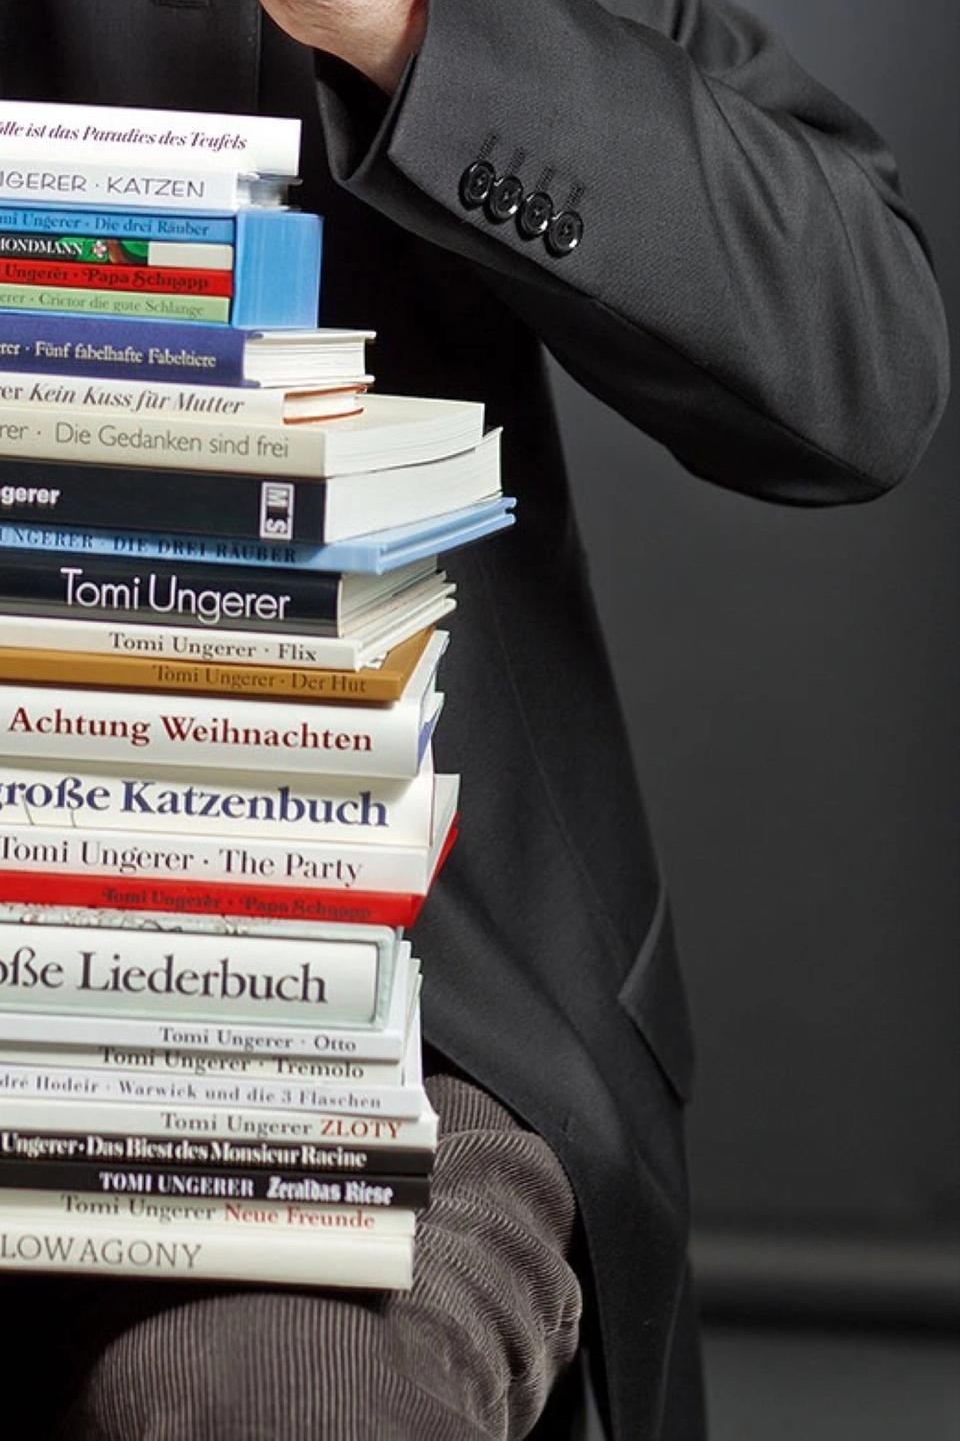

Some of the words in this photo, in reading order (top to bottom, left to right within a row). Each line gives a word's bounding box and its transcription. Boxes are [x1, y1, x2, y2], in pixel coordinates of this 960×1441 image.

[26, 123, 47, 137] ist
[49, 124, 80, 140] das
[83, 125, 157, 145] Paradies
[159, 130, 188, 147] des
[190, 131, 248, 151] Teufels
[107, 176, 206, 198] KATZEN
[22, 213, 83, 230] Ungerer
[95, 219, 121, 233] Die
[122, 219, 152, 233] drei
[82, 268, 129, 285] Papa
[132, 270, 209, 291] Schnapp
[88, 295, 110, 310] die
[113, 299, 141, 314] gute
[145, 299, 204, 318] Schlange
[75, 343, 142, 364] fabelhafte
[148, 348, 217, 368] Fabeltiere
[29, 382, 77, 405] Kein
[82, 385, 131, 406] Kuss
[131, 390, 170, 413] für
[172, 391, 246, 415] Mutter
[55, 421, 91, 445] Die
[98, 424, 203, 452] Gedanken
[209, 433, 250, 456] sind
[256, 435, 289, 458] frei
[113, 535, 150, 553] DIE
[157, 538, 207, 558] DREI
[60, 566, 141, 610] Tomi
[148, 573, 291, 624] Ungerer
[109, 632, 164, 652] Tomi
[173, 636, 257, 660] Ungerer
[278, 642, 318, 662] Flix
[152, 664, 199, 684] Tomi
[205, 668, 275, 689] Ungerer
[291, 672, 326, 691] Der
[331, 676, 367, 693] Hut
[7, 707, 151, 747] Achtung
[160, 715, 373, 752] Weihnachten
[121, 779, 390, 827] Katzenbuch
[80, 840, 195, 873] Ungerer
[219, 848, 276, 877] The
[285, 856, 366, 887] Party
[76, 950, 328, 1004] Liederbuch
[159, 1027, 209, 1044] Tomi
[217, 1029, 294, 1052] Ungerer
[313, 1034, 357, 1053] Otto
[97, 1046, 155, 1067] Tomi
[164, 1049, 251, 1076] Ungerer
[273, 1056, 365, 1080] Tremolo
[36, 1075, 99, 1094] Hodeir
[119, 1079, 197, 1099] Warwick
[205, 1084, 240, 1102] und
[246, 1086, 276, 1104] die
[281, 1090, 293, 1105] 3
[299, 1090, 382, 1109] Flaschen
[161, 1112, 218, 1132] Tomi
[227, 1115, 313, 1139] Ungerer
[320, 1118, 403, 1139] ZLOTY
[1, 1132, 78, 1158] Ungerer
[86, 1135, 125, 1157] Das
[126, 1137, 174, 1159] Biest
[174, 1140, 208, 1161] des
[211, 1141, 301, 1165] Monsieur
[301, 1145, 368, 1168] Racine
[99, 1171, 152, 1192] TOMI
[158, 1175, 254, 1197] UNGERER
[61, 1193, 119, 1216] Tomi
[129, 1197, 216, 1223] Ungerer
[224, 1204, 279, 1223] Neue
[286, 1209, 375, 1229] Freunde
